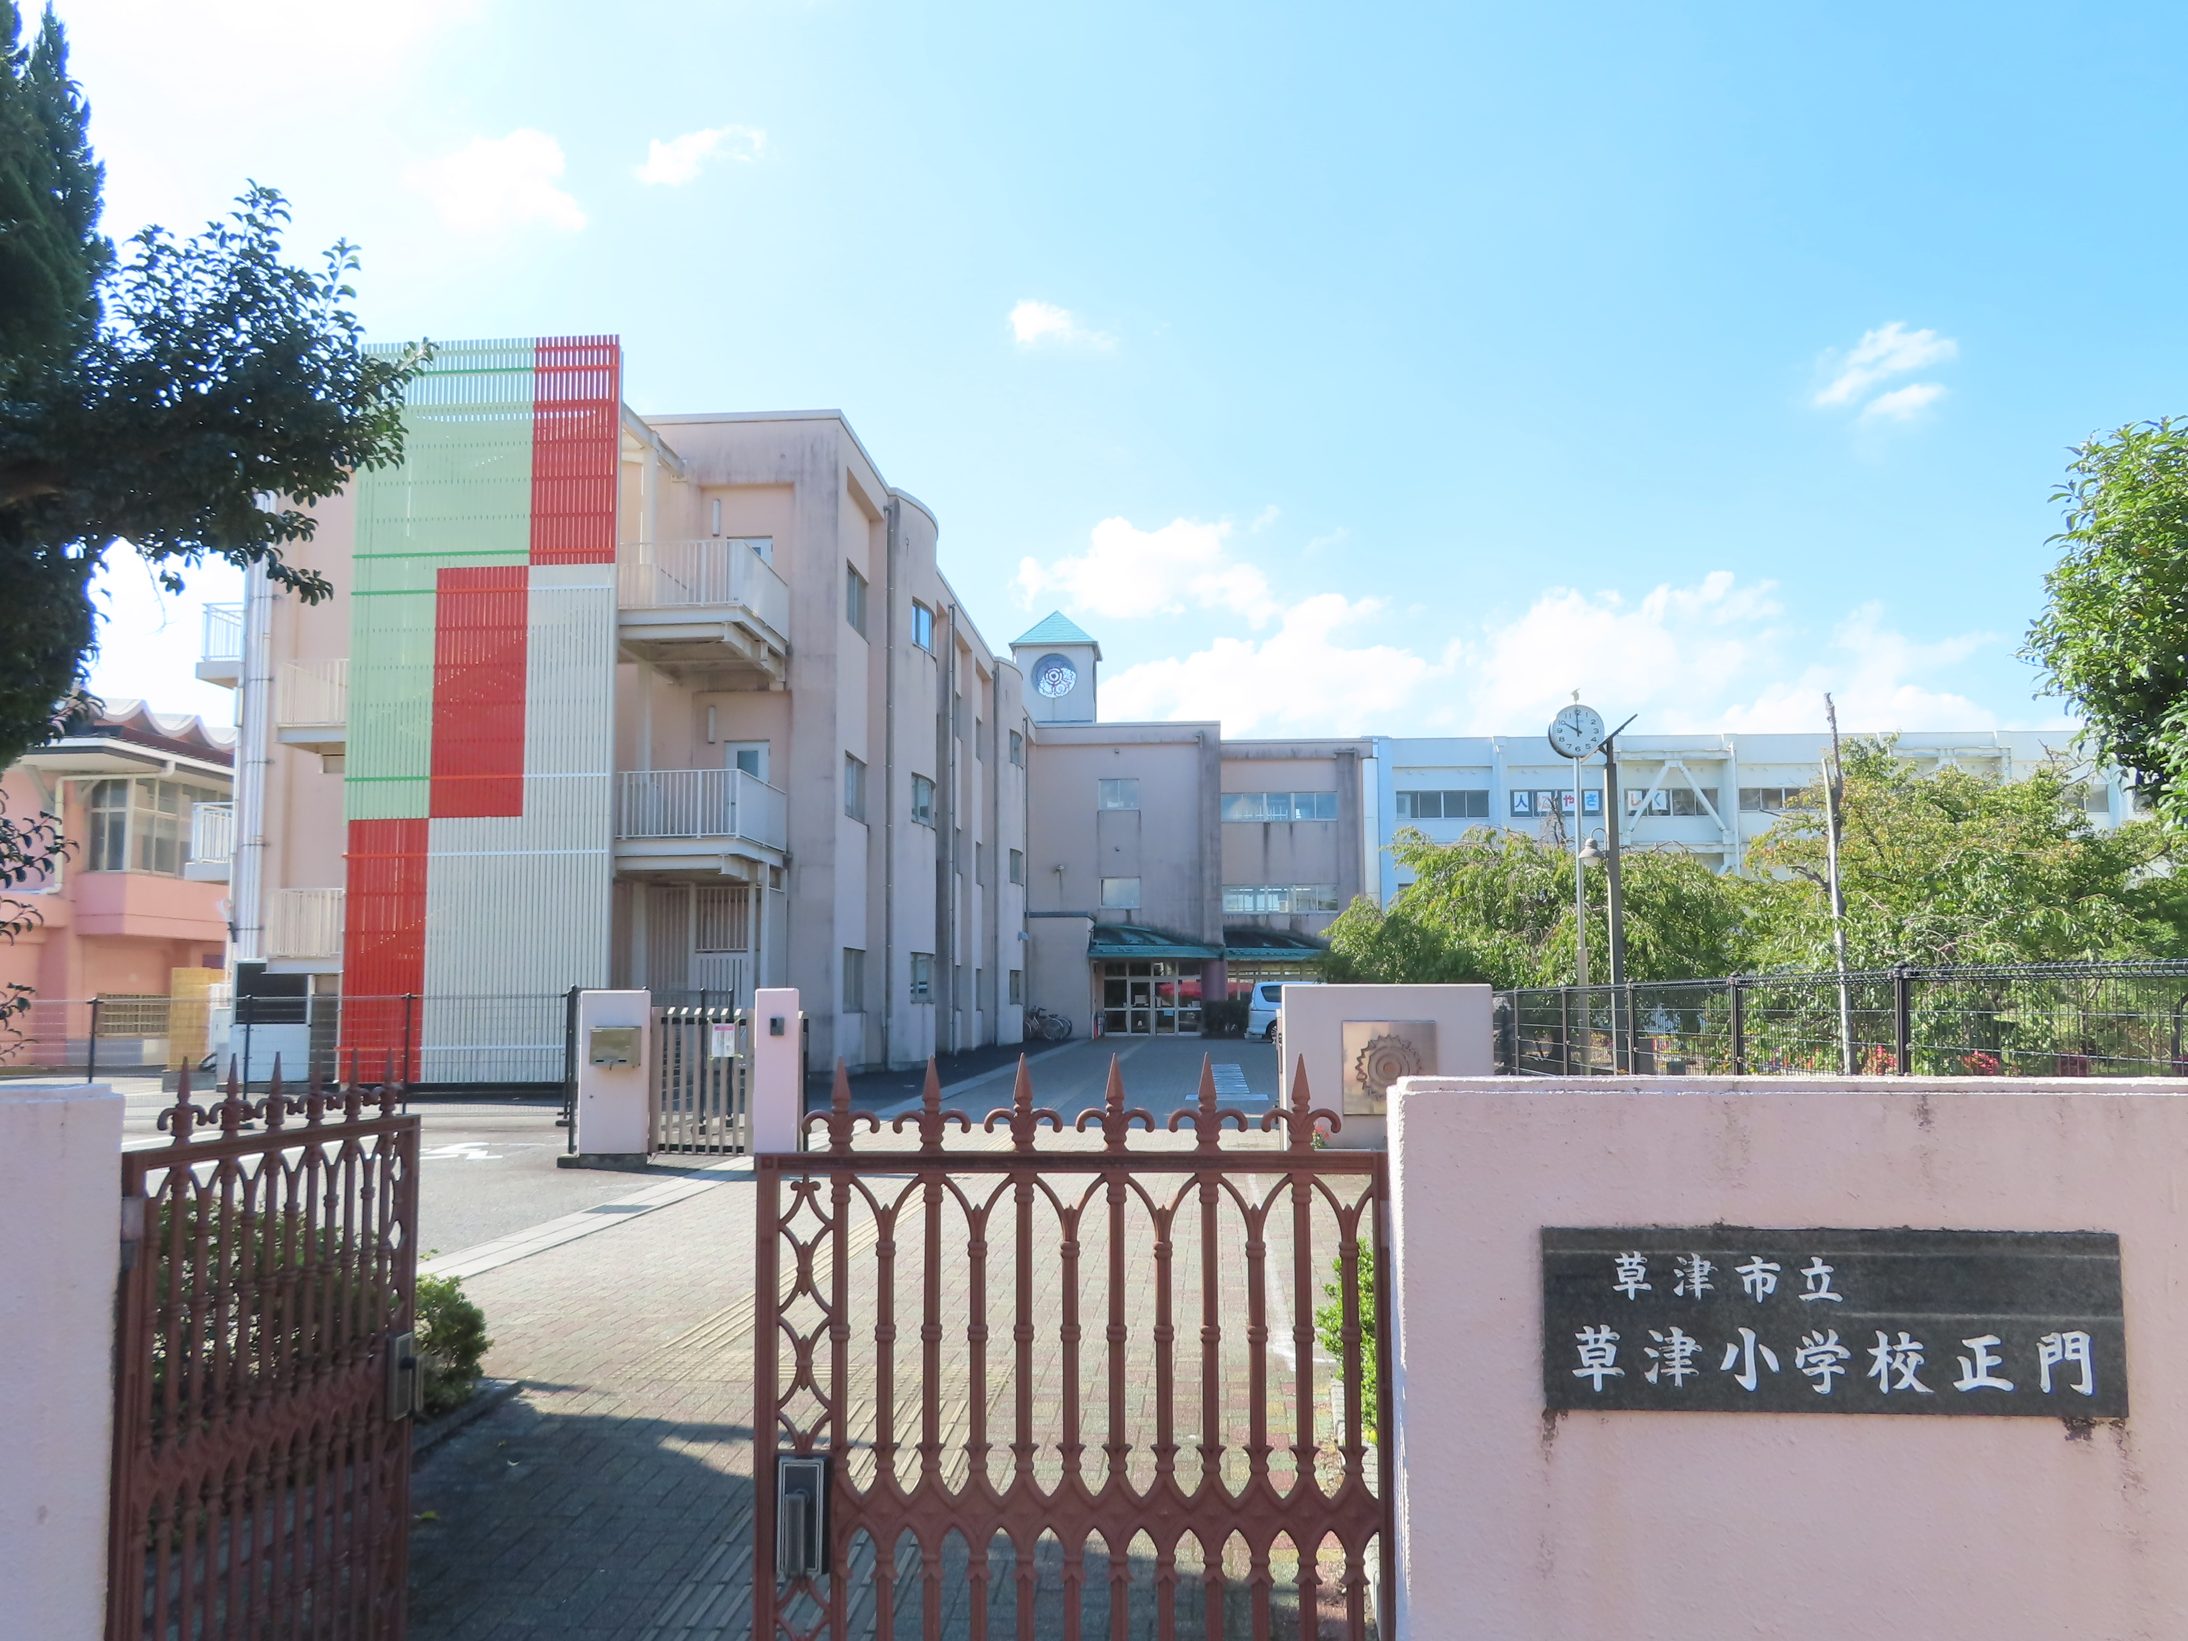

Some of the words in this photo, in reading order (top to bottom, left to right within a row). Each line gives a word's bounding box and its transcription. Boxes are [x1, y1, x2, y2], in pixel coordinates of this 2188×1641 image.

[1612, 1252, 1843, 1303] 草津市立
[1572, 1324, 2095, 1396] 草津小学校正門
